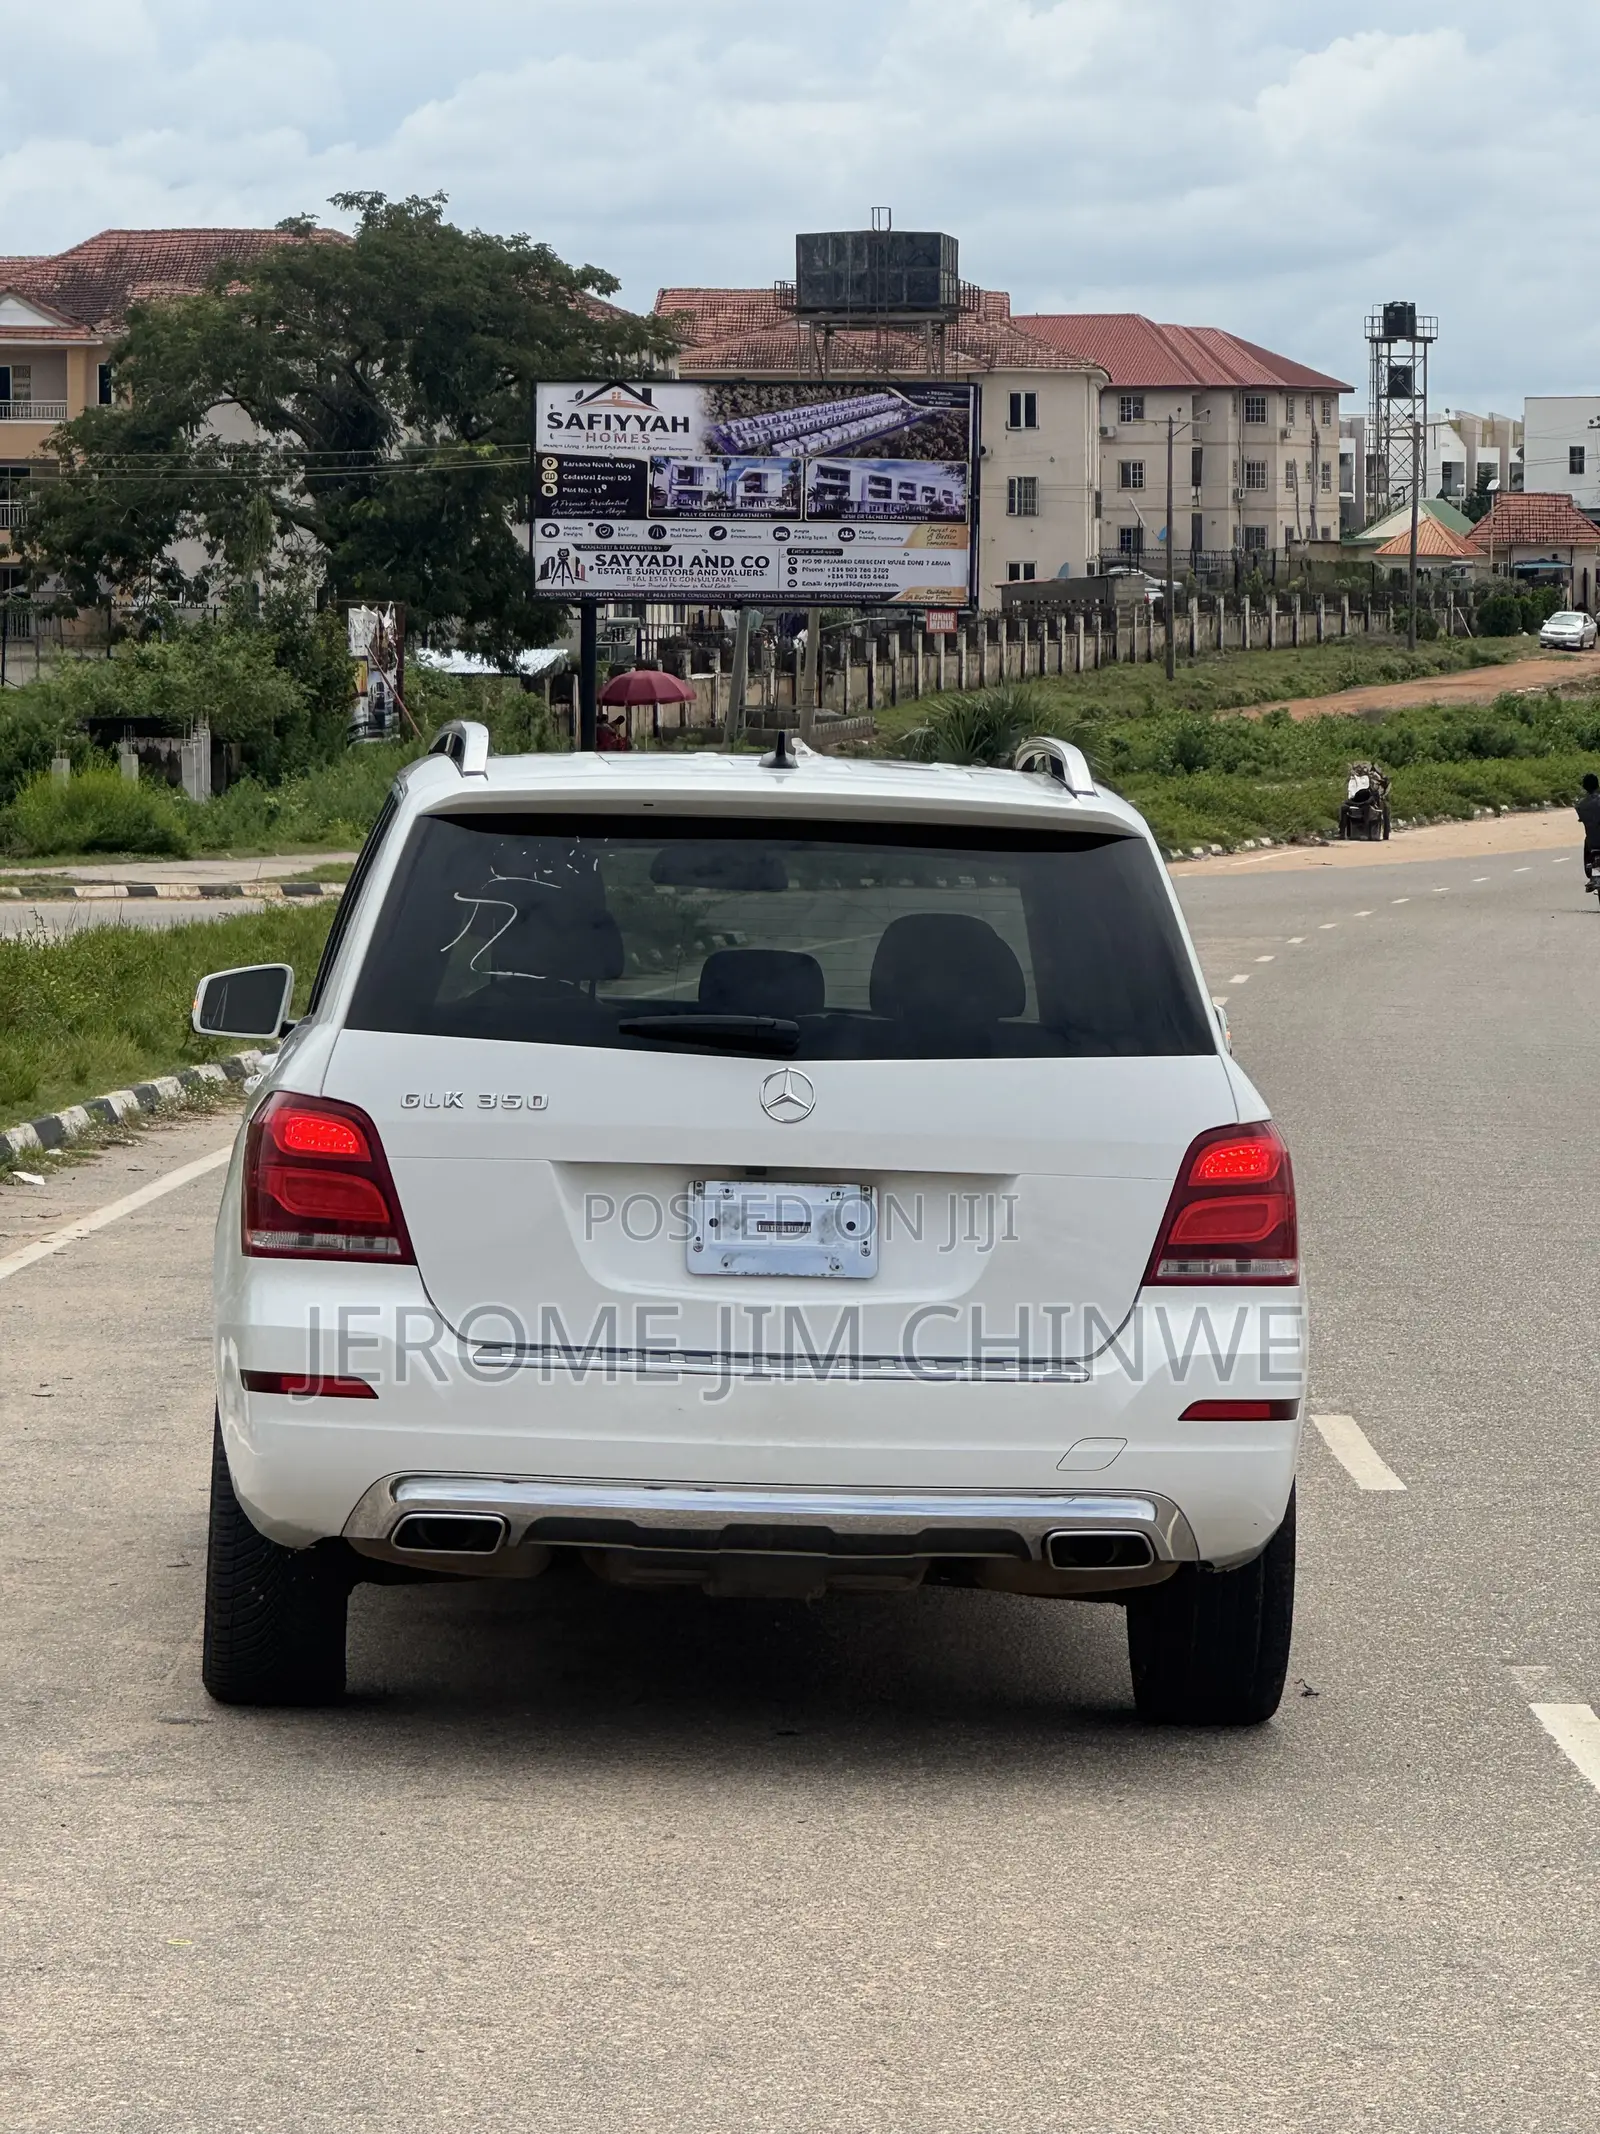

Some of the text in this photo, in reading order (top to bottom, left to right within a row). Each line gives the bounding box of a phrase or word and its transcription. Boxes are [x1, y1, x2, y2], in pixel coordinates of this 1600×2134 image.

[547, 412, 689, 432] SAFIYYAH
[586, 432, 651, 444] HOMES
[551, 508, 595, 516] Development
[595, 554, 770, 568] SAYYADI AND CO
[635, 568, 694, 576] SURVEYORS
[400, 1091, 549, 1110] GLK 350
